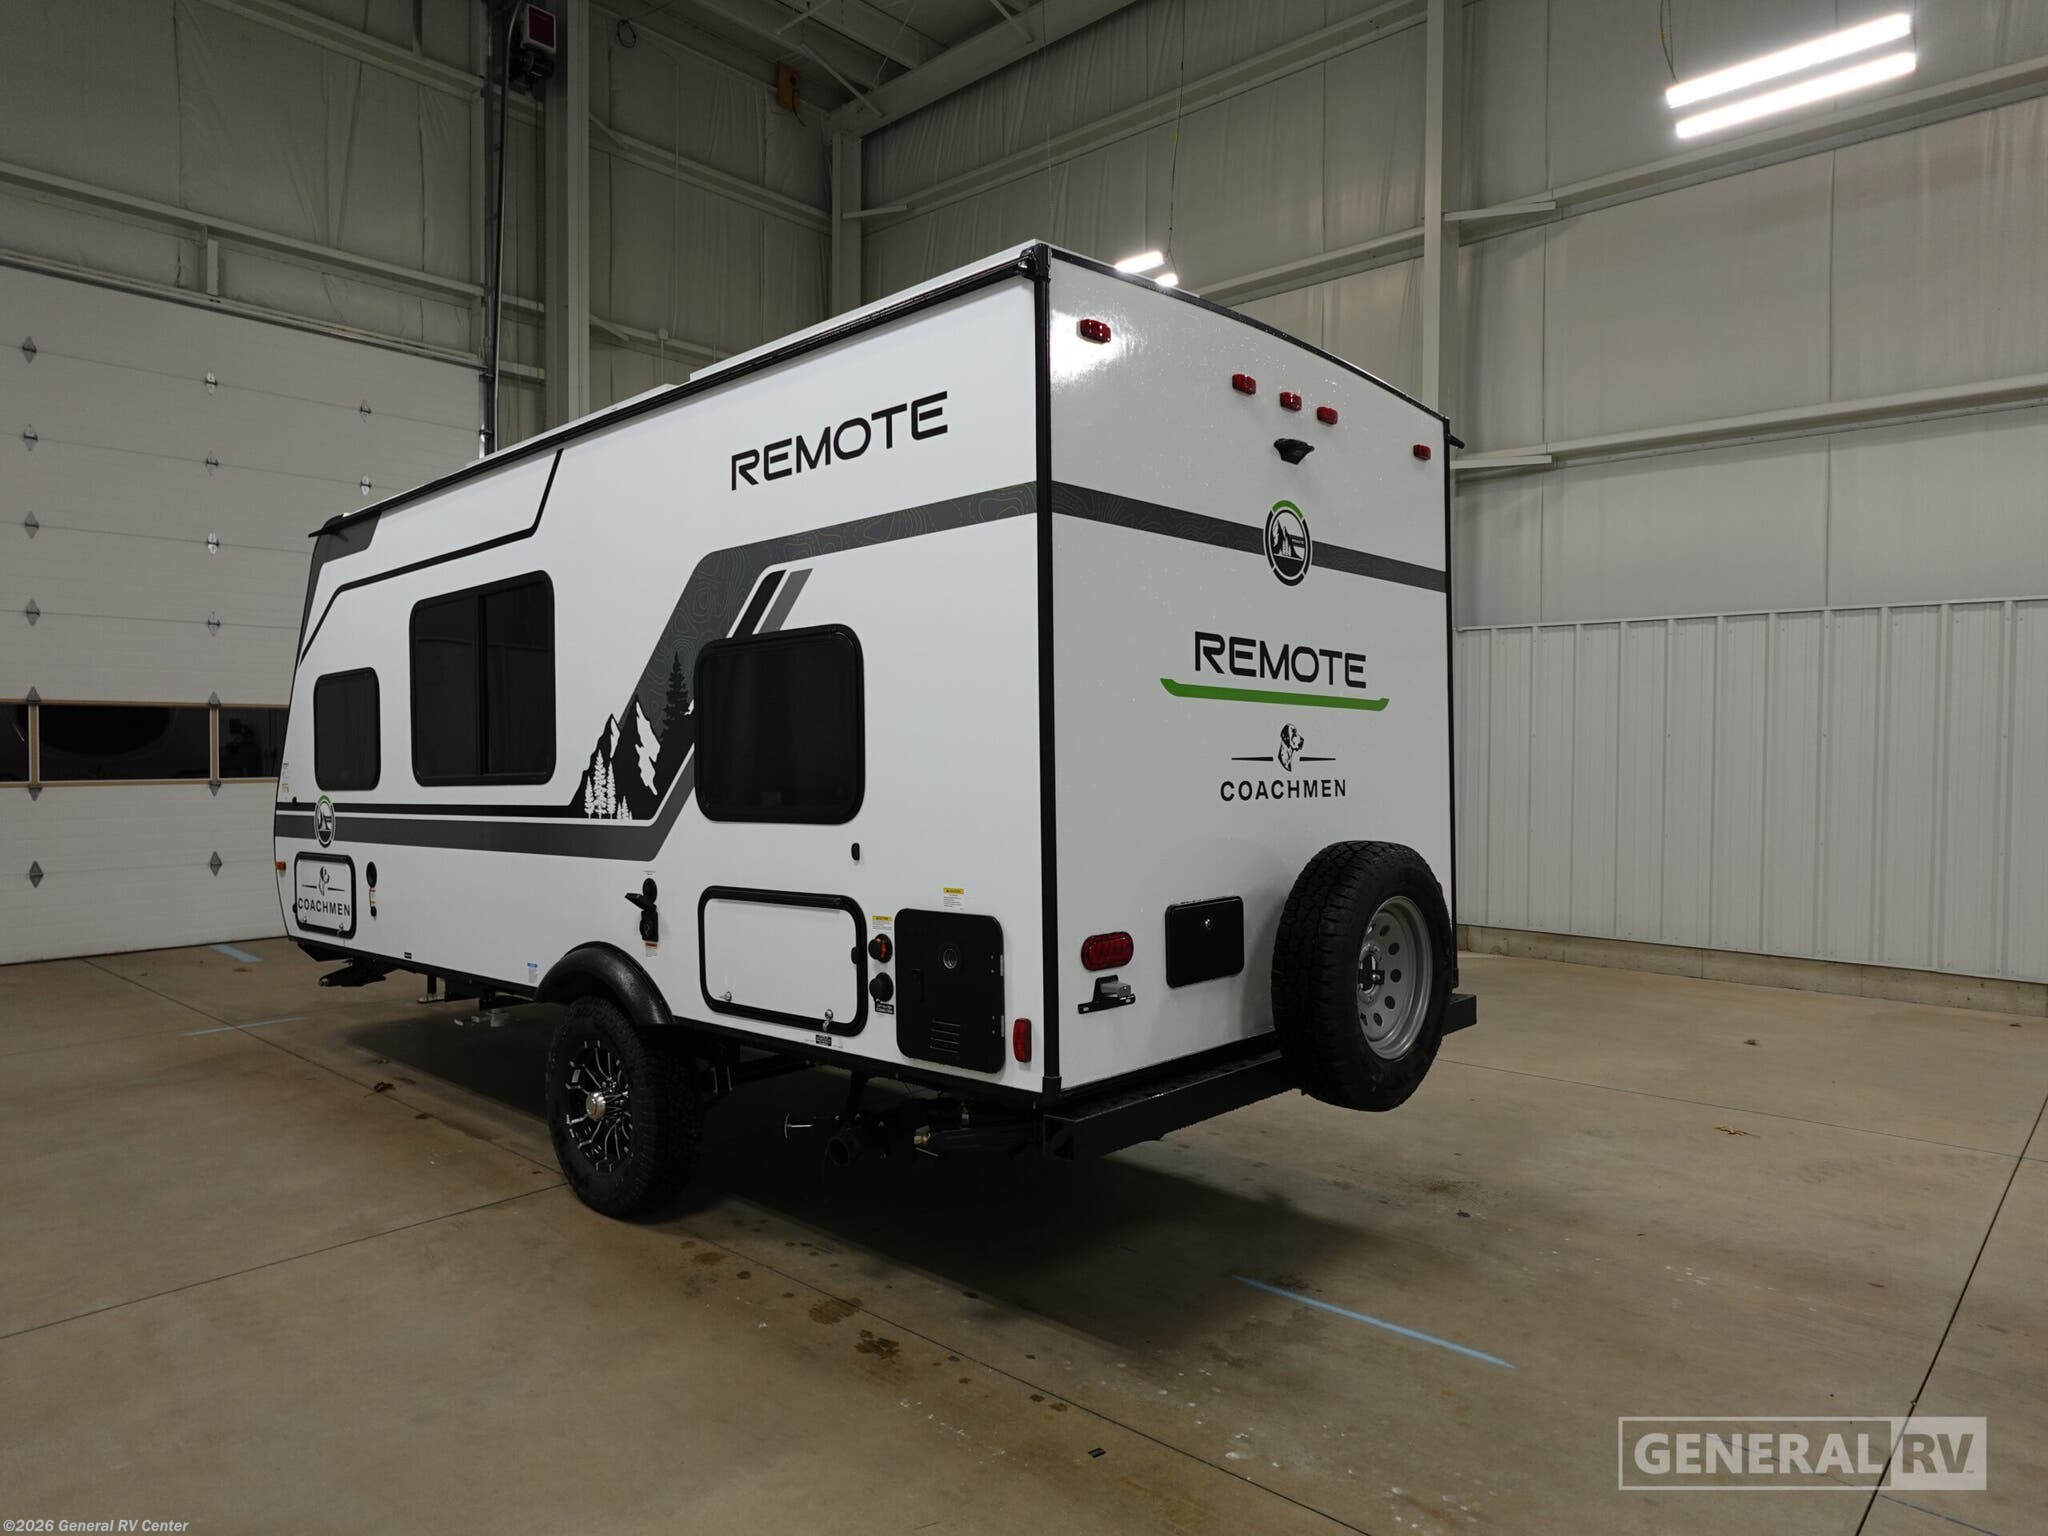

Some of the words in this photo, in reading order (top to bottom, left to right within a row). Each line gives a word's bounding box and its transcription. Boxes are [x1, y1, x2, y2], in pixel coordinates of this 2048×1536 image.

[731, 390, 948, 491] REMOTE
[1195, 631, 1366, 689] REMOTE
[1220, 779, 1346, 801] COACHMEN
[298, 898, 350, 916] COACHMEN
